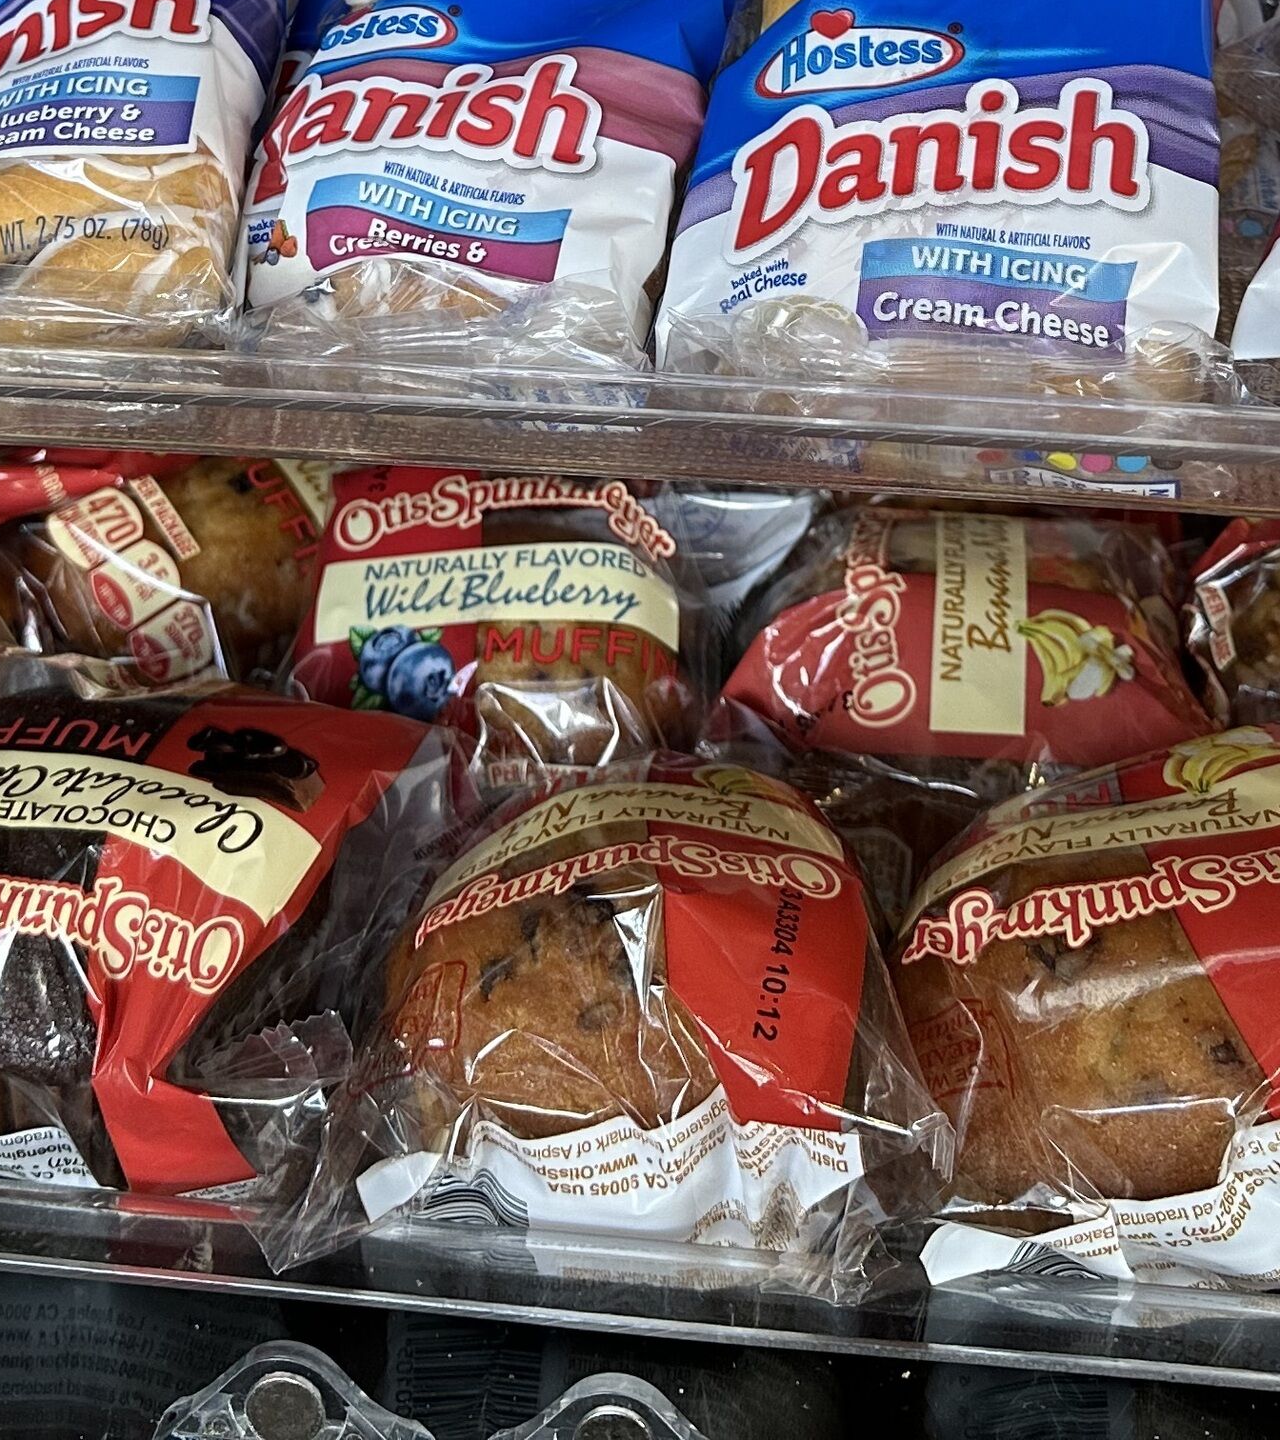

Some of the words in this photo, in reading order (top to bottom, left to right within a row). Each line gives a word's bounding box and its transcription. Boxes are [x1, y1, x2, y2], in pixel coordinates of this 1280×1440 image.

[320, 10, 439, 52] ostess
[66, 74, 149, 97] ICING
[72, 57, 113, 73] ARTIFICIAL
[114, 54, 150, 71] FLAVORS
[780, 32, 943, 93] Hostess
[53, 122, 156, 144] Cheese
[120, 102, 143, 123] &
[383, 161, 407, 178] WITH
[407, 168, 439, 189] NATURAL
[449, 179, 490, 201] ARTIFICIAL
[490, 188, 525, 206] FLAVORS
[733, 90, 1139, 252] Danish
[357, 180, 433, 221] WITH
[439, 205, 519, 237] ICING
[35, 215, 75, 246] 2.75
[82, 215, 112, 241] OZ.
[120, 215, 170, 250] (78g)
[367, 217, 460, 259] Berries
[466, 243, 488, 264] &
[935, 222, 959, 240] WITH
[960, 224, 997, 244] NATURAL
[998, 230, 1008, 245] &
[1008, 230, 1052, 250] ARTIFICIAL
[1053, 233, 1092, 252] FLAVORS
[730, 266, 762, 291] baked
[765, 258, 790, 275] with
[911, 245, 992, 278] WITH
[999, 257, 1089, 291] ICING
[719, 281, 752, 314] Real
[754, 270, 808, 299] Cheese
[873, 289, 986, 330] Cream
[993, 300, 1110, 349] Cheese
[365, 550, 507, 582] NATURALLY
[514, 547, 647, 578] FLAVORED
[365, 584, 455, 621] Wild
[458, 570, 640, 623] Blueberry
[939, 559, 967, 682] NATURALLY
[484, 627, 679, 679] MUFFIN
[45, 765, 264, 853] Chocolate
[614, 805, 790, 843] NATURALLY
[457, 809, 605, 882] FLAVORED
[414, 835, 725, 949] Spunkmeyer
[725, 852, 843, 901] Otis
[770, 887, 802, 956] 3A3304
[901, 855, 1236, 964] Spunkmeyer
[145, 915, 245, 995] Otis
[752, 961, 788, 1042] 10:12
[577, 1140, 595, 1159] of
[547, 1180, 586, 1197] USA
[590, 1173, 640, 1197] 90045
[643, 1170, 670, 1190] CA
